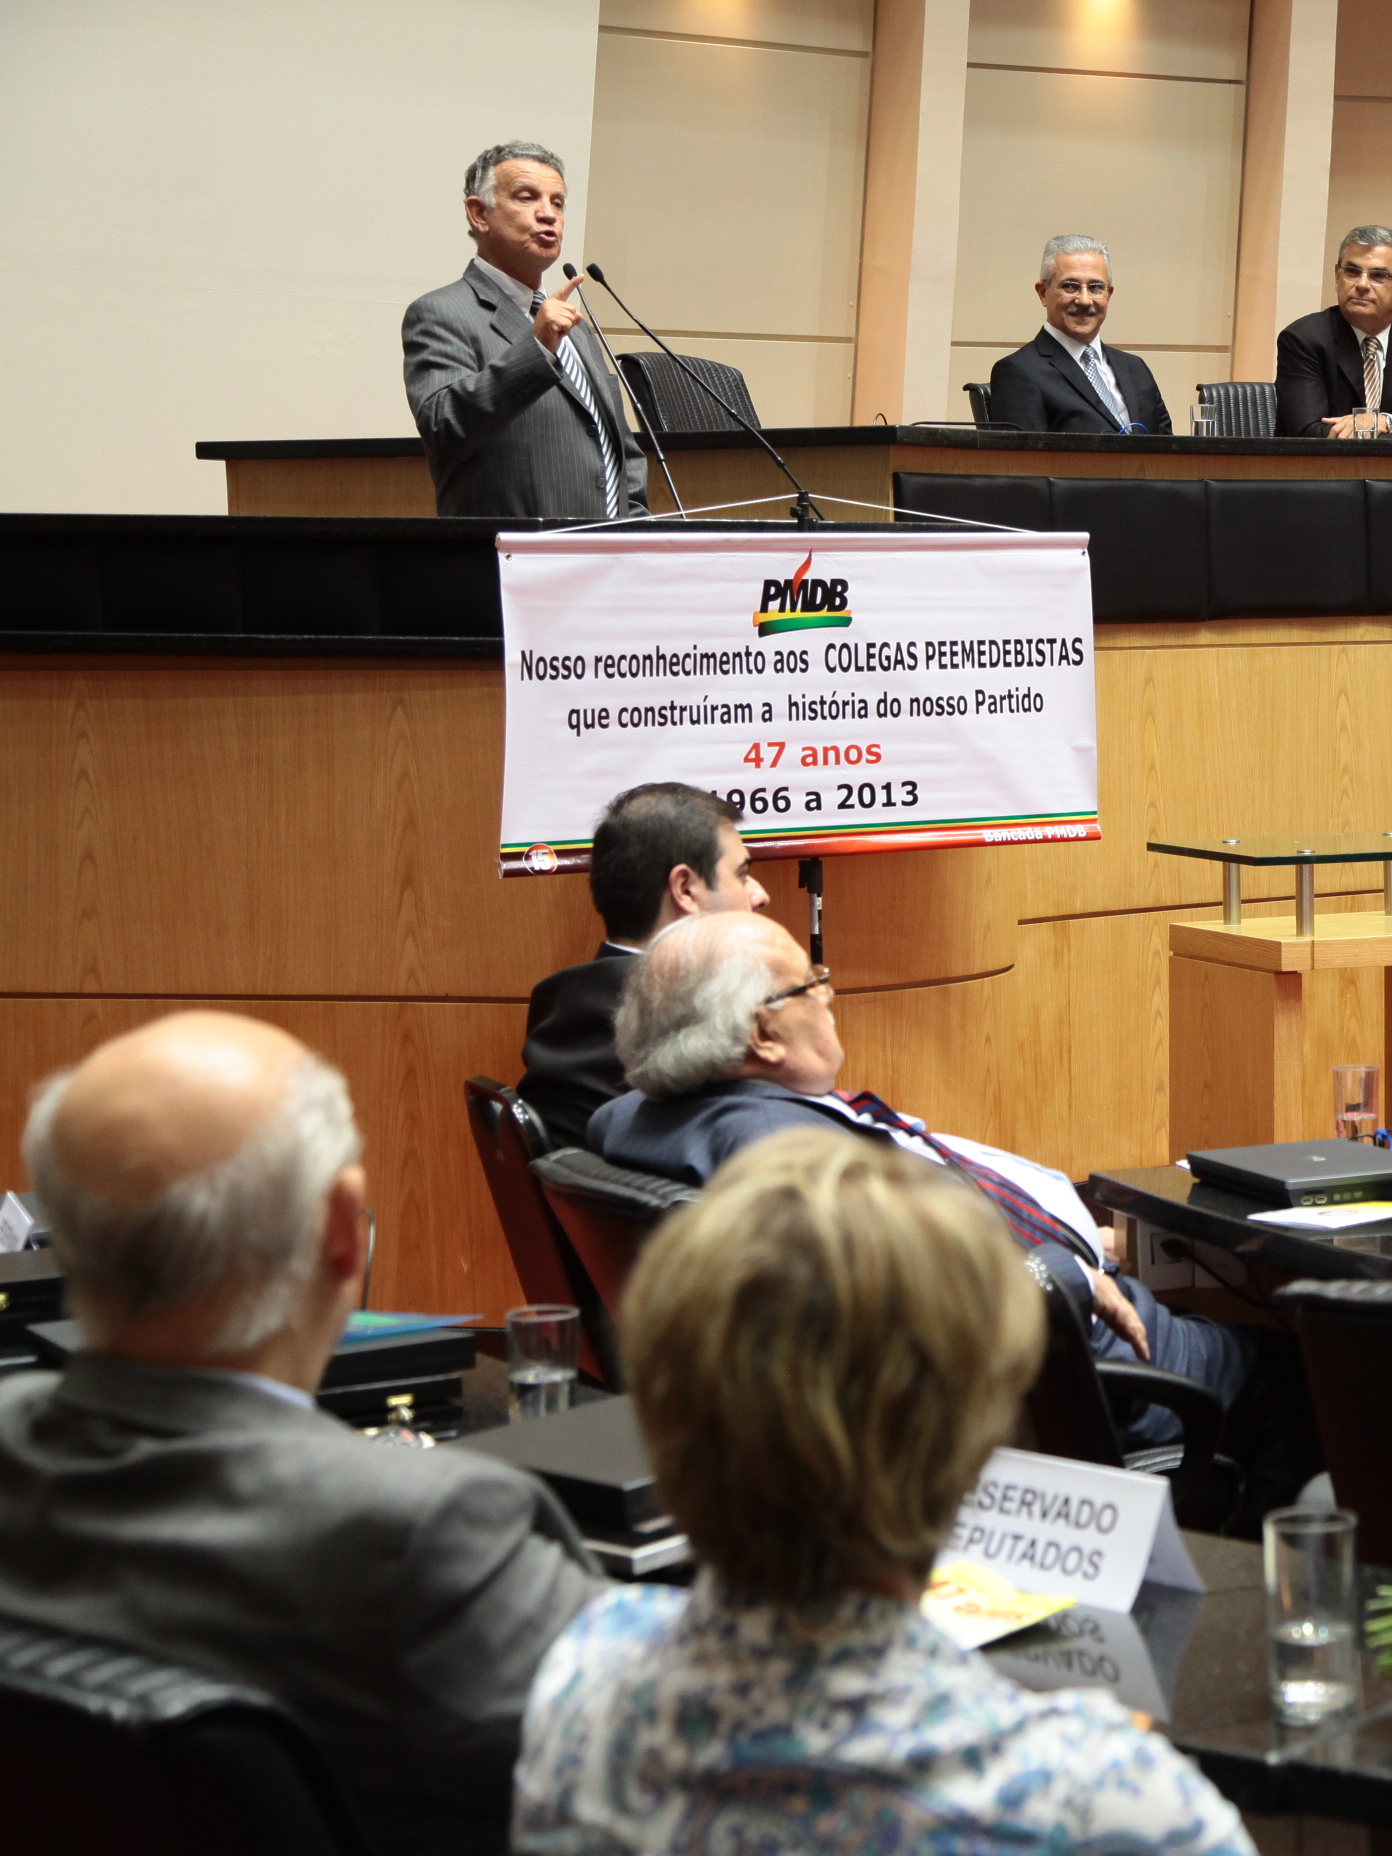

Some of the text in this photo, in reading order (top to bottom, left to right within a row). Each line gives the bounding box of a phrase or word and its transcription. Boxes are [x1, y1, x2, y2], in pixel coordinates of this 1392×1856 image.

[760, 578, 849, 614] PMDB
[520, 637, 1084, 681] Nosso reconhecimento aos COLEGAS PEEMEDEBISTAS
[568, 686, 1044, 737] que construíram a história do nosso Partido
[743, 741, 882, 770] 47 anos
[711, 780, 919, 814] 966 a 2013
[982, 824, 1087, 842] Bancada PMDB
[528, 850, 552, 870] 15
